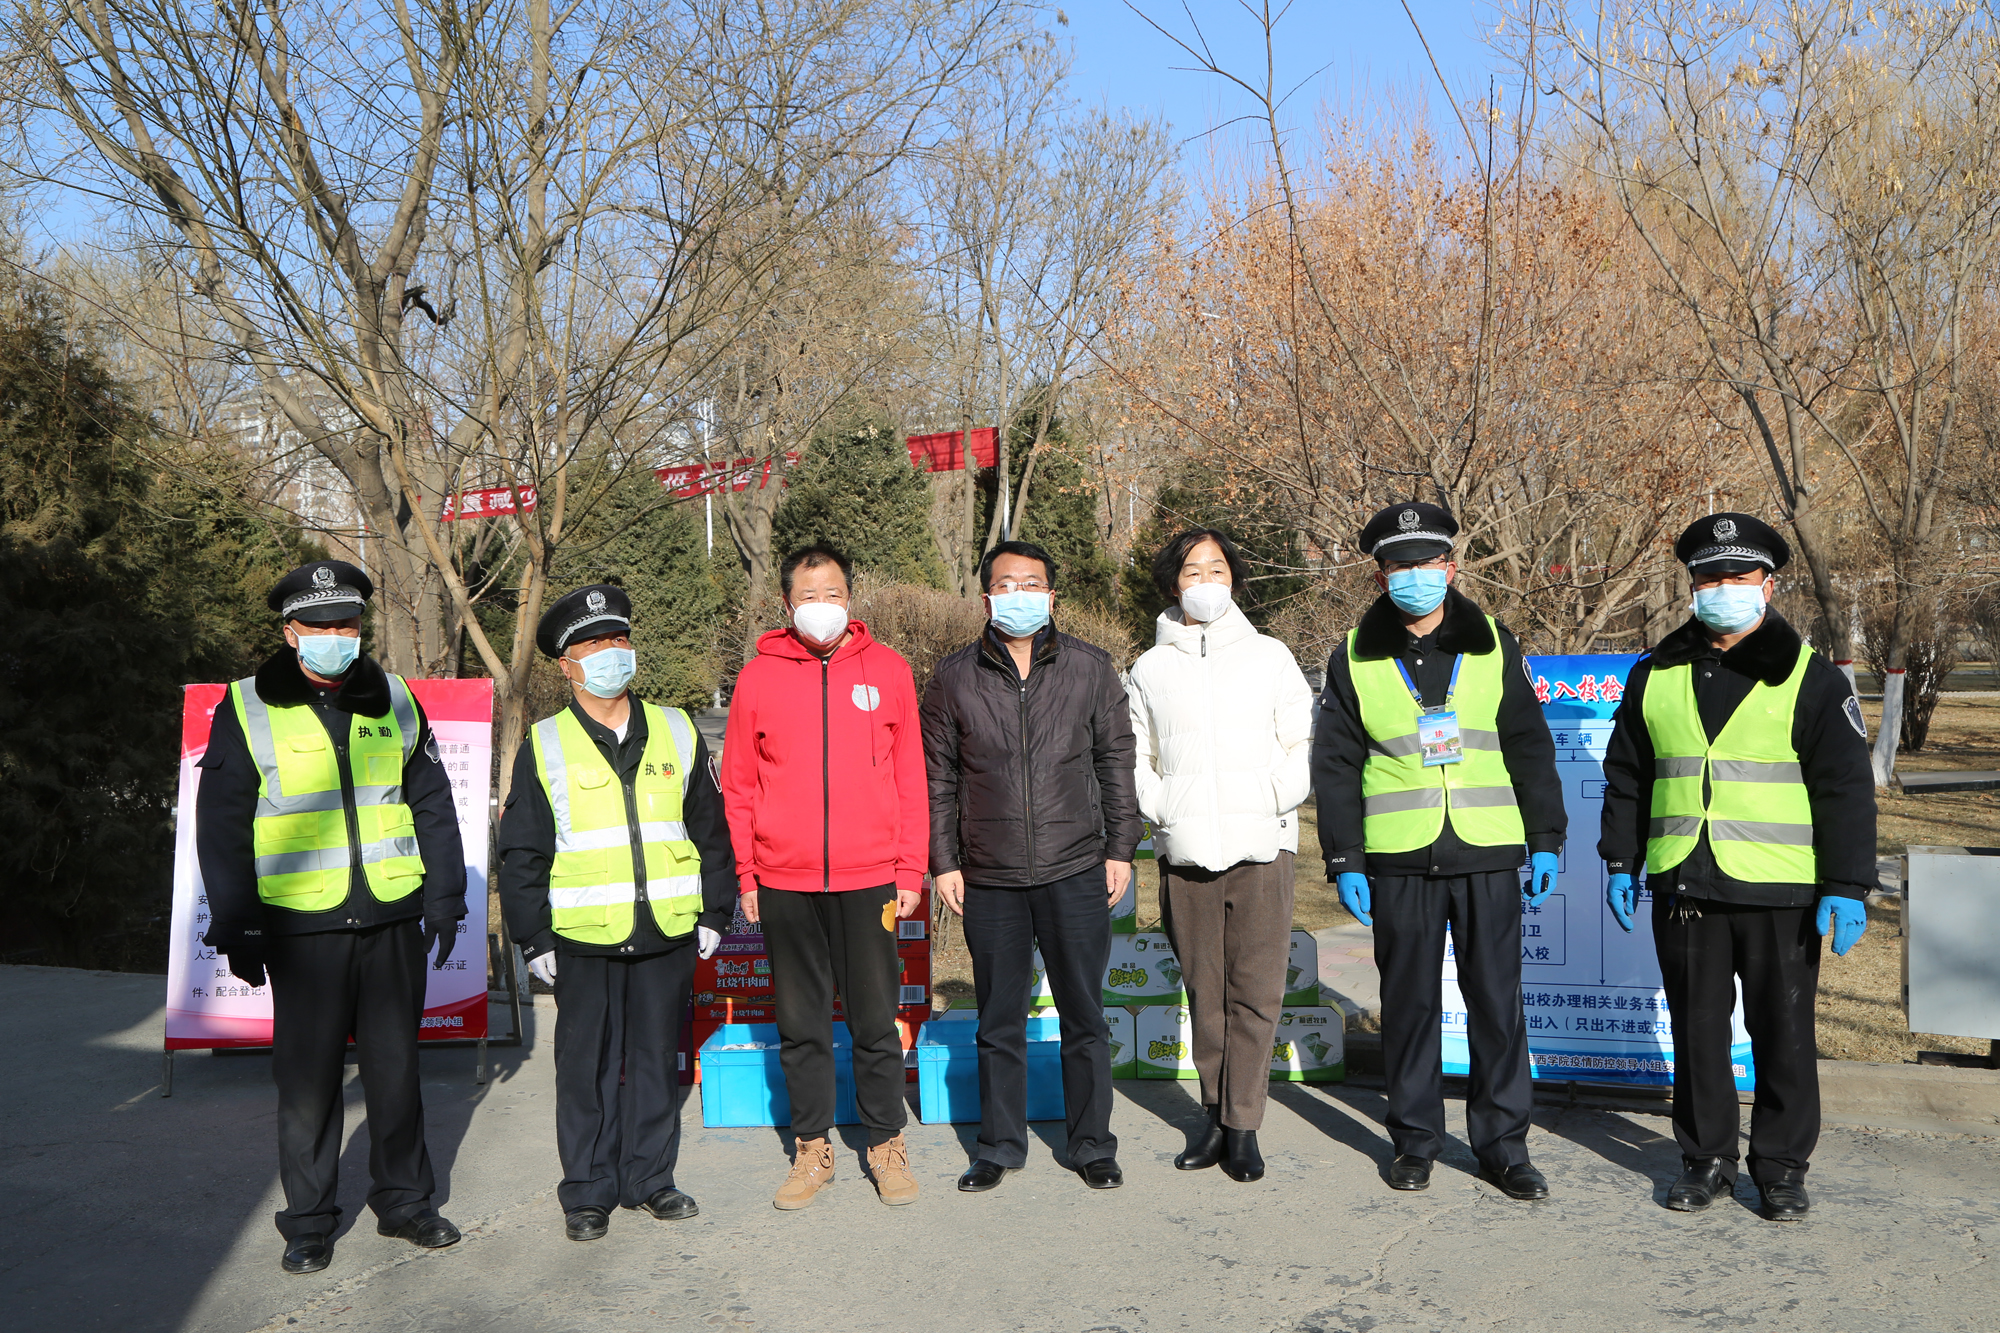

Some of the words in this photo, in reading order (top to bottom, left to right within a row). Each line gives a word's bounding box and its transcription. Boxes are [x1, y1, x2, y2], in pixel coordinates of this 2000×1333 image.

[358, 725, 392, 738] 执勤
[1555, 732, 1592, 746] 车辆
[442, 762, 469, 771] 的面
[645, 762, 675, 776] 执勤
[458, 797, 468, 807] 或
[198, 895, 208, 905] 安
[457, 922, 467, 933] 的
[194, 950, 217, 960] 人之
[1521, 946, 1550, 960] 入校
[716, 976, 770, 988] 红烧牛肉面
[1108, 968, 1149, 988] 酸牛奶
[1148, 1041, 1188, 1061] 酸牛奶
[1529, 1054, 1674, 1073] 河西学院疫情防控领导小组安
